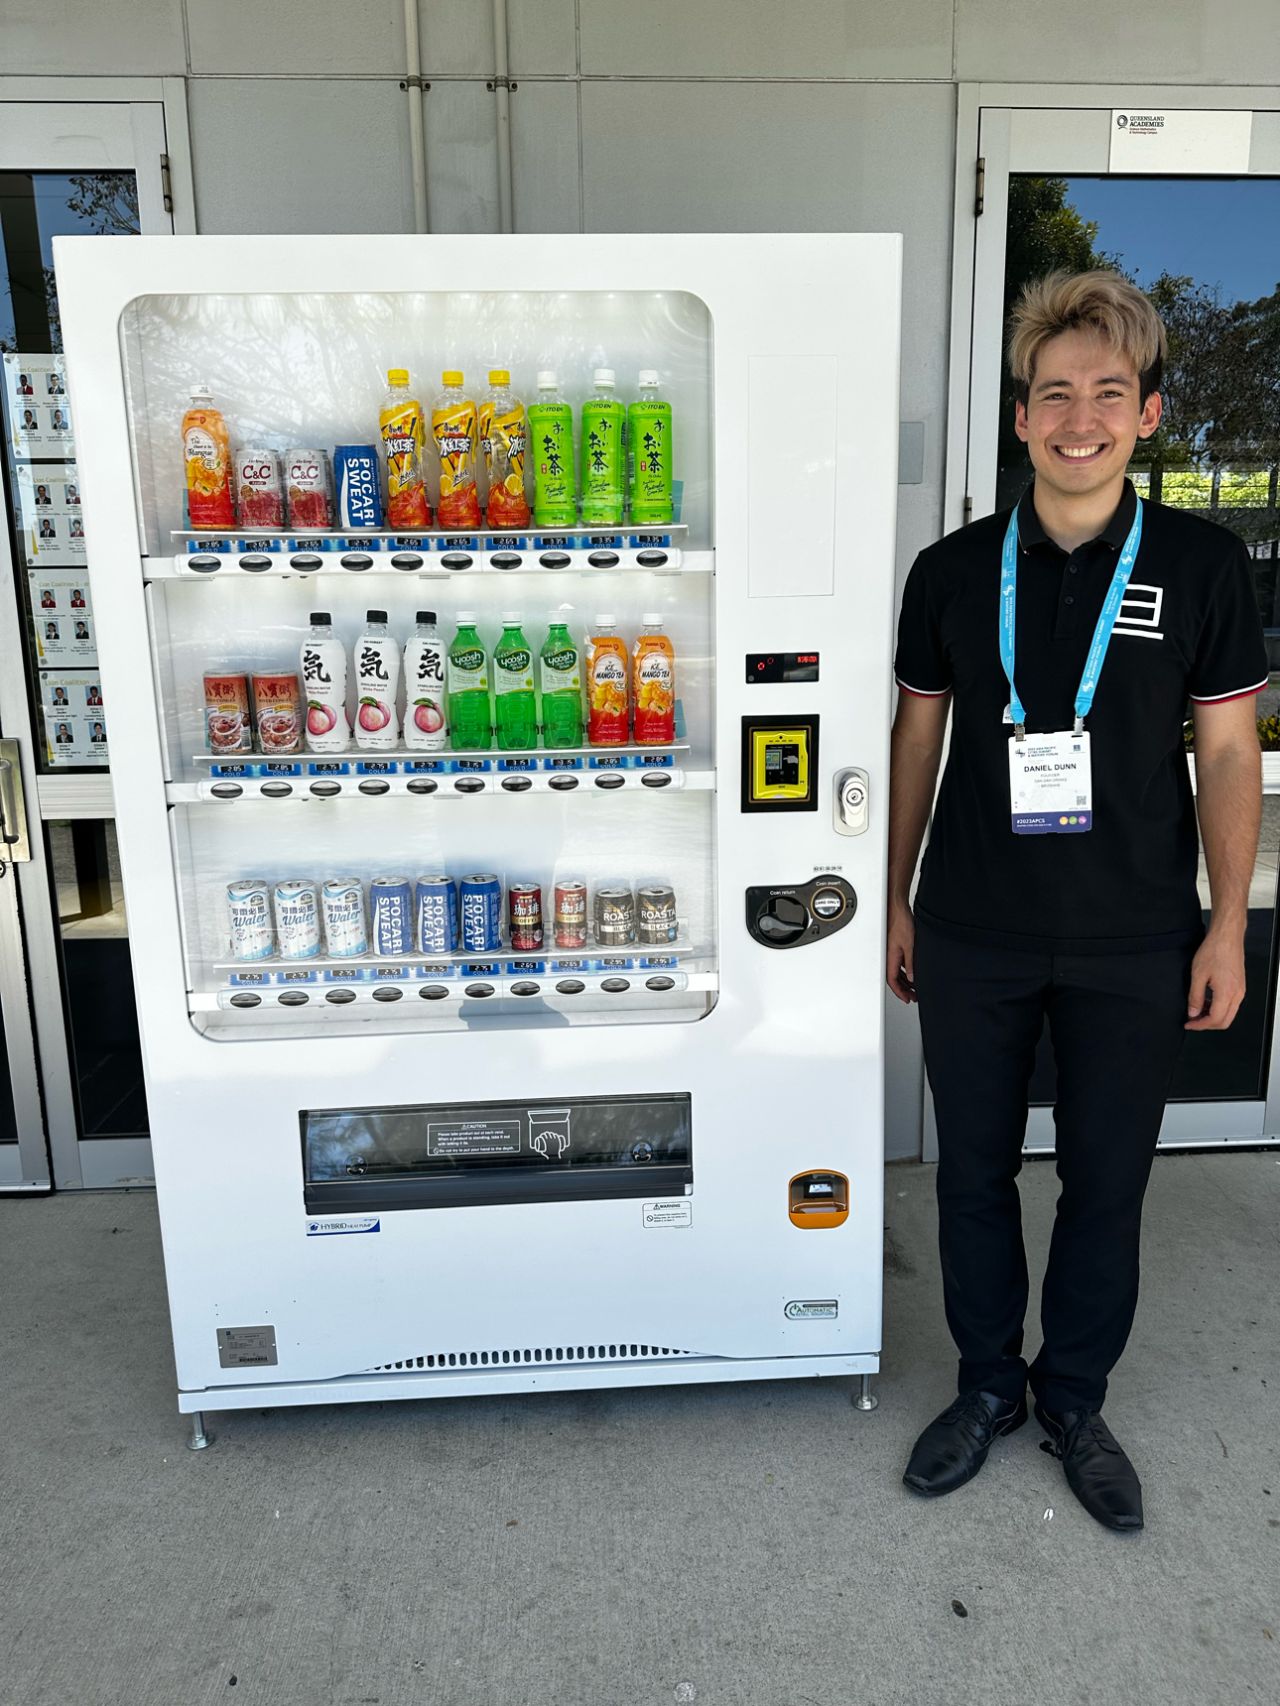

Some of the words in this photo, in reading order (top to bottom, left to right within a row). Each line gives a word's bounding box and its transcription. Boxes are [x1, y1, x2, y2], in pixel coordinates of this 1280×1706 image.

[243, 465, 271, 479] C&C
[291, 466, 318, 479] C&C
[543, 434, 565, 476] お茶
[589, 432, 609, 473] お茶
[643, 432, 664, 474] お茶
[348, 458, 364, 520] SWEAT
[359, 458, 375, 526] POCARI
[232, 913, 267, 927] Water
[282, 912, 316, 926] Water
[328, 910, 361, 924] Water
[379, 897, 393, 949] SWEAT
[390, 896, 404, 954] POCARI
[423, 895, 436, 947] SWEAT
[432, 895, 446, 952] POCARI
[464, 894, 476, 946] SWEAT
[472, 894, 486, 951] POCARI
